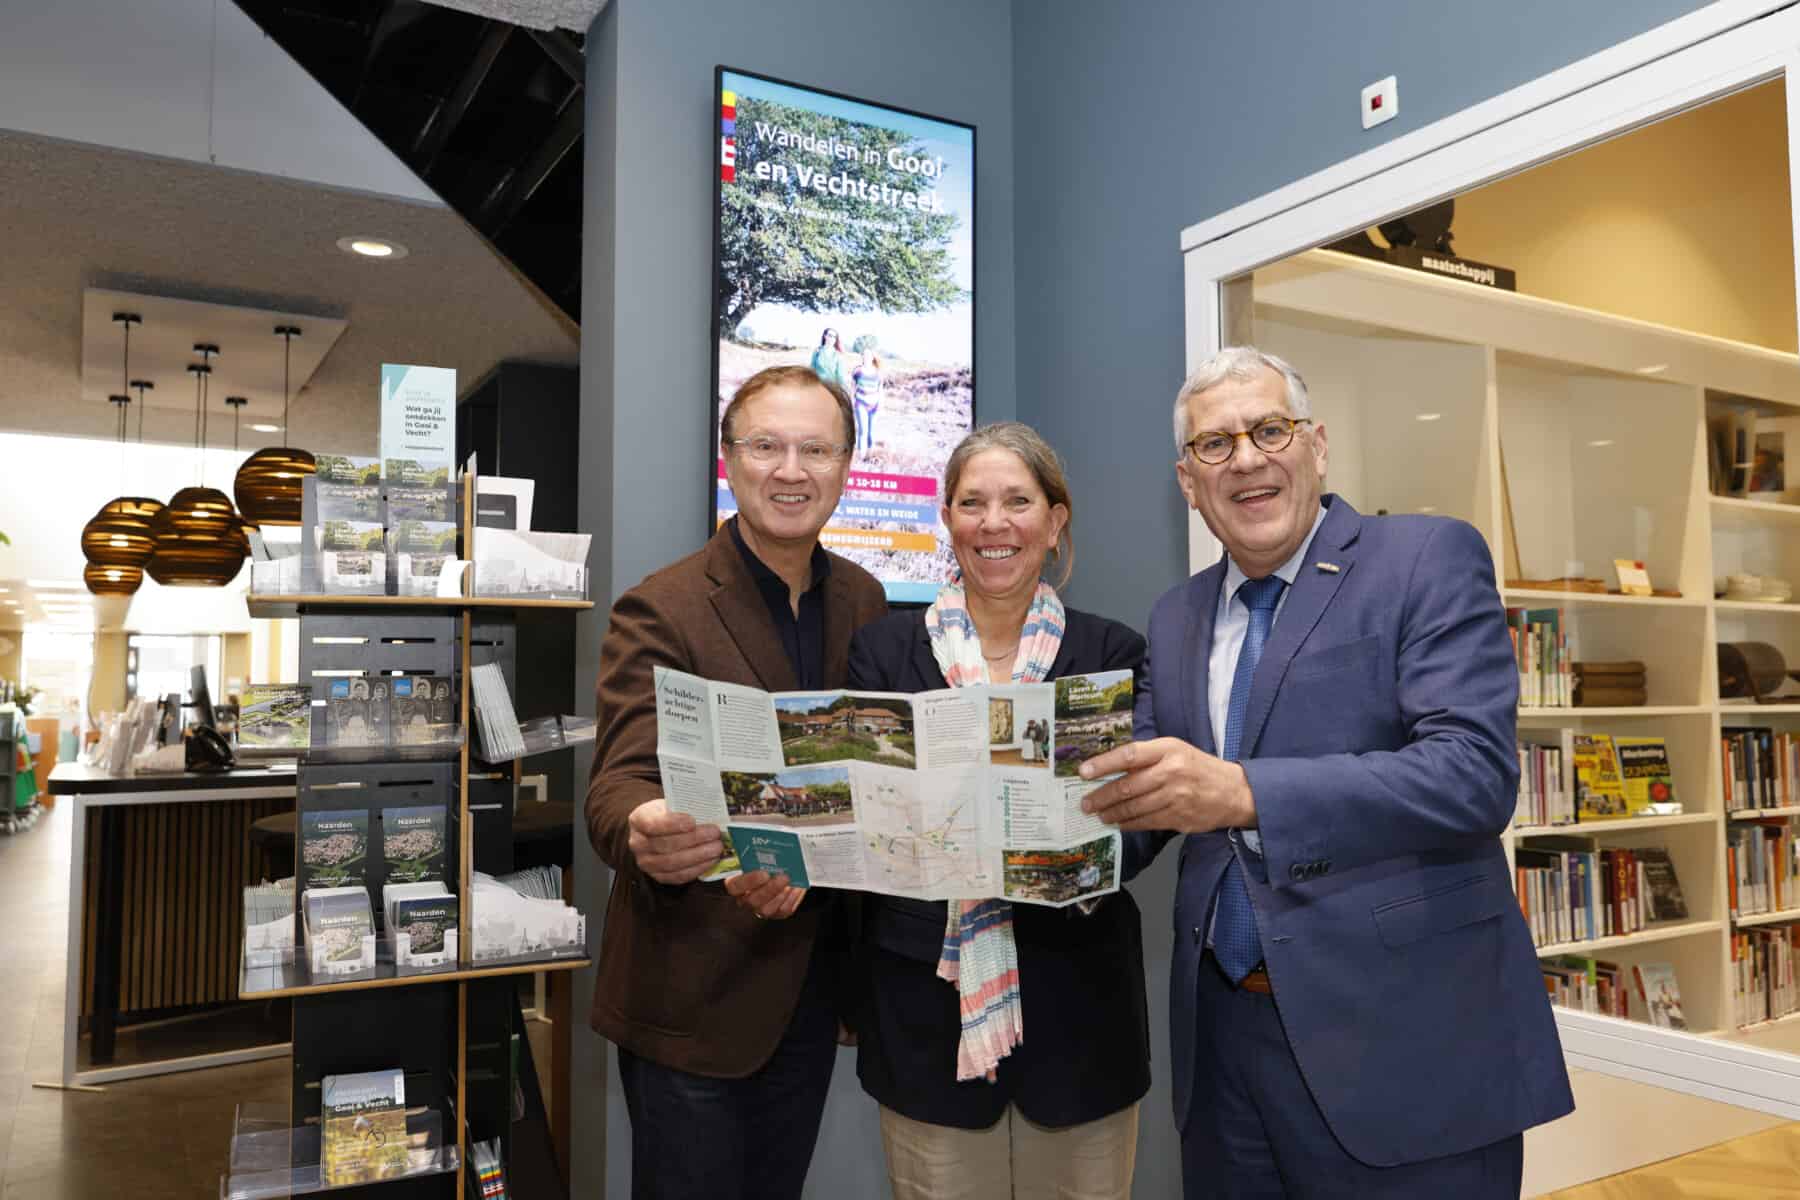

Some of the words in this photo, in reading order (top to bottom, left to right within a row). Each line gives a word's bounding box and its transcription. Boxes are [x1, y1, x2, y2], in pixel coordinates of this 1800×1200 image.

[755, 121, 859, 160] Wandelen
[864, 145, 881, 166] in
[887, 148, 943, 178] Gooi
[755, 161, 787, 183] en
[795, 164, 945, 214] Vechtstreek
[1421, 257, 1495, 285] maatschappij
[318, 821, 352, 829] Naarden
